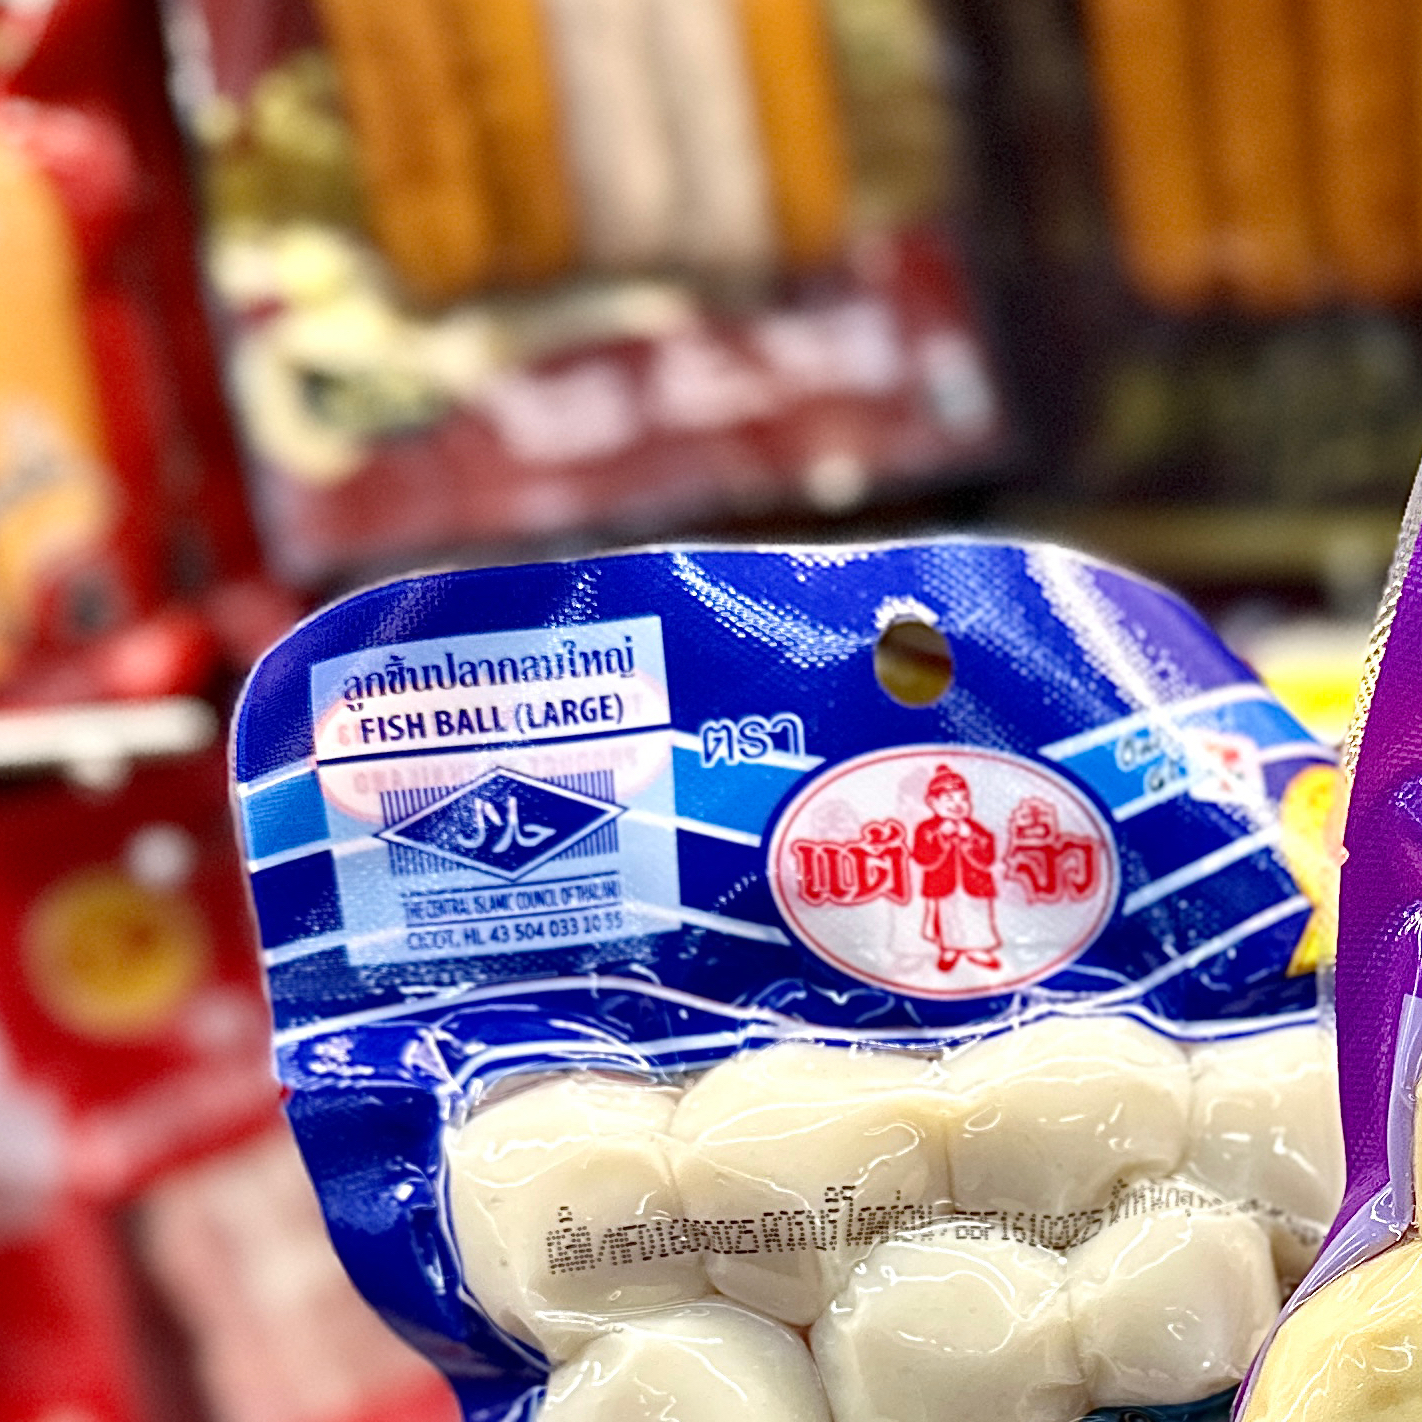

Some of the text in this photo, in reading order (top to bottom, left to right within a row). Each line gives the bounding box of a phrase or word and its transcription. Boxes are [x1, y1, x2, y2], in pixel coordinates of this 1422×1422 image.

[343, 636, 636, 712] ลูกชิ้นปลากลมใหญ่
[360, 692, 625, 744] FISH BALL (LARGE)
[701, 712, 805, 768] ตรา
[490, 924, 510, 943] 43
[549, 917, 579, 937] 033
